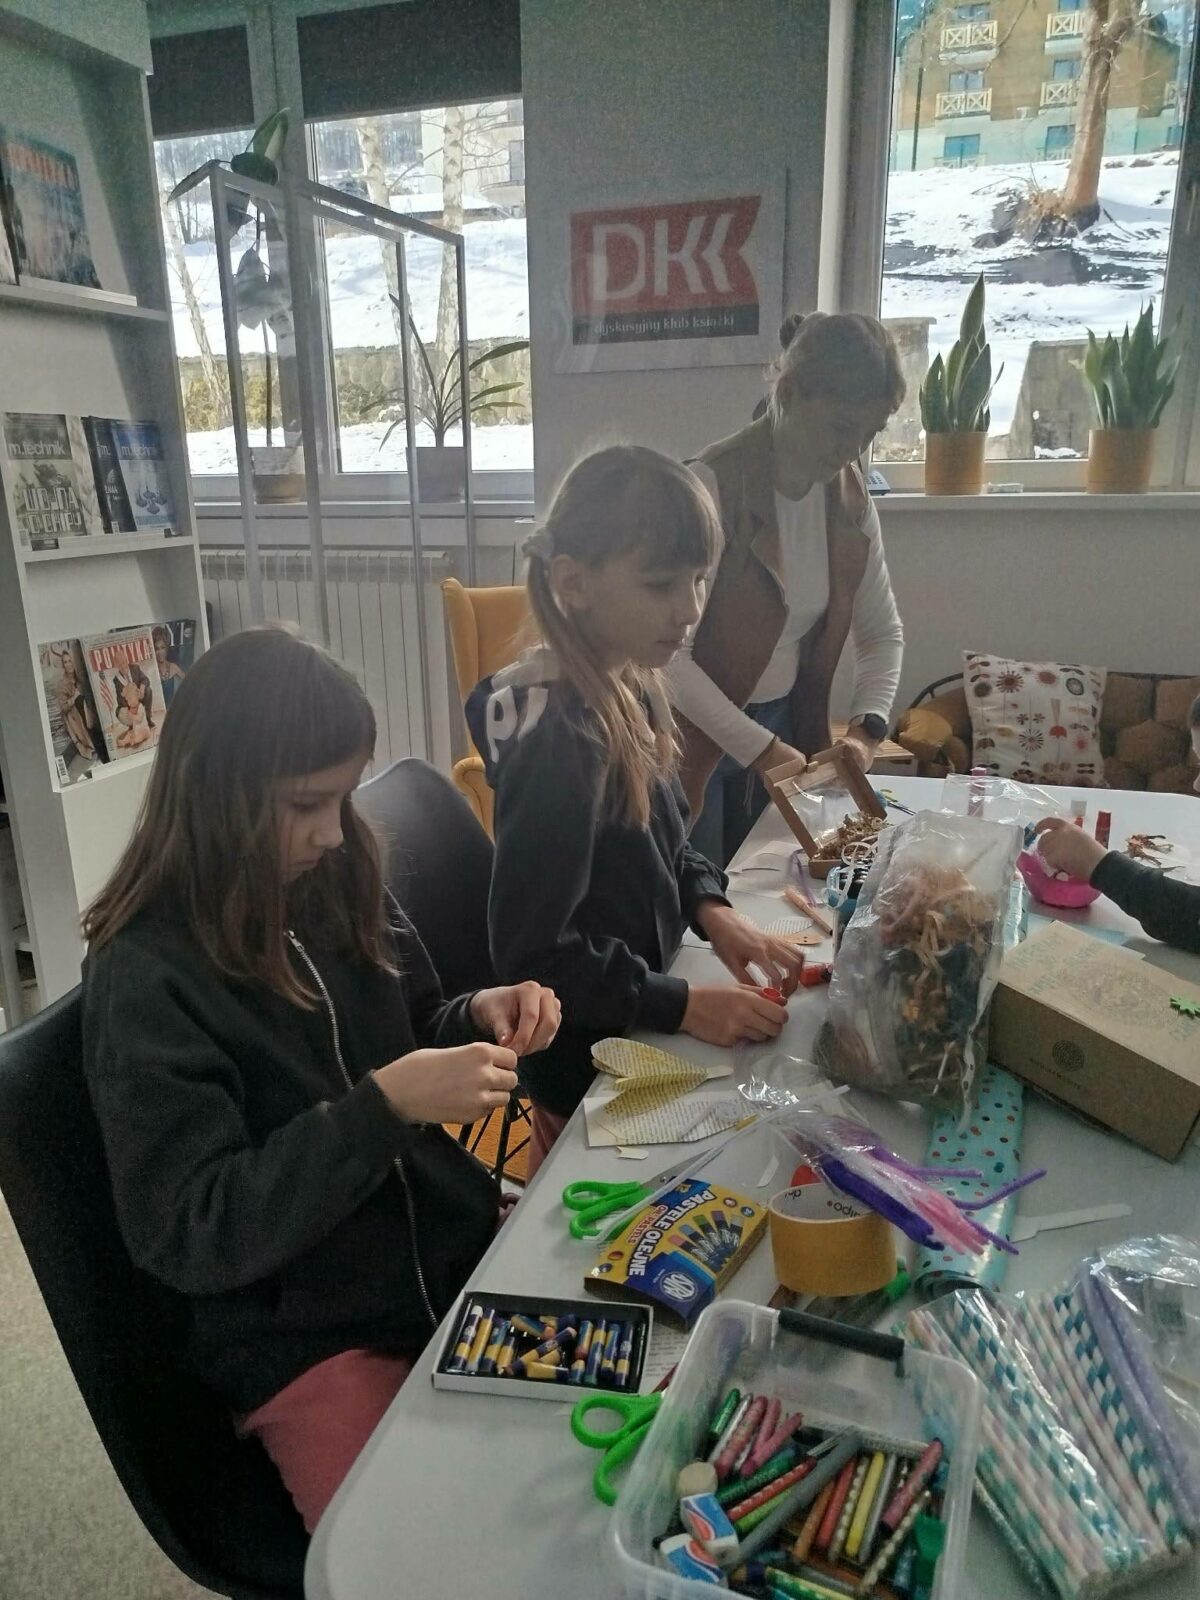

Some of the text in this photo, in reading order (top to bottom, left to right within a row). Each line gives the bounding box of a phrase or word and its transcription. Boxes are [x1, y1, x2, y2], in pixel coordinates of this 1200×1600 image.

[594, 319, 660, 336] dyskusyjny
[663, 315, 690, 330] klub
[8, 441, 66, 456] m.technik
[93, 639, 151, 671] POTYKA
[655, 1189, 716, 1230] PASTELE
[628, 1230, 662, 1277] OLEJNE
